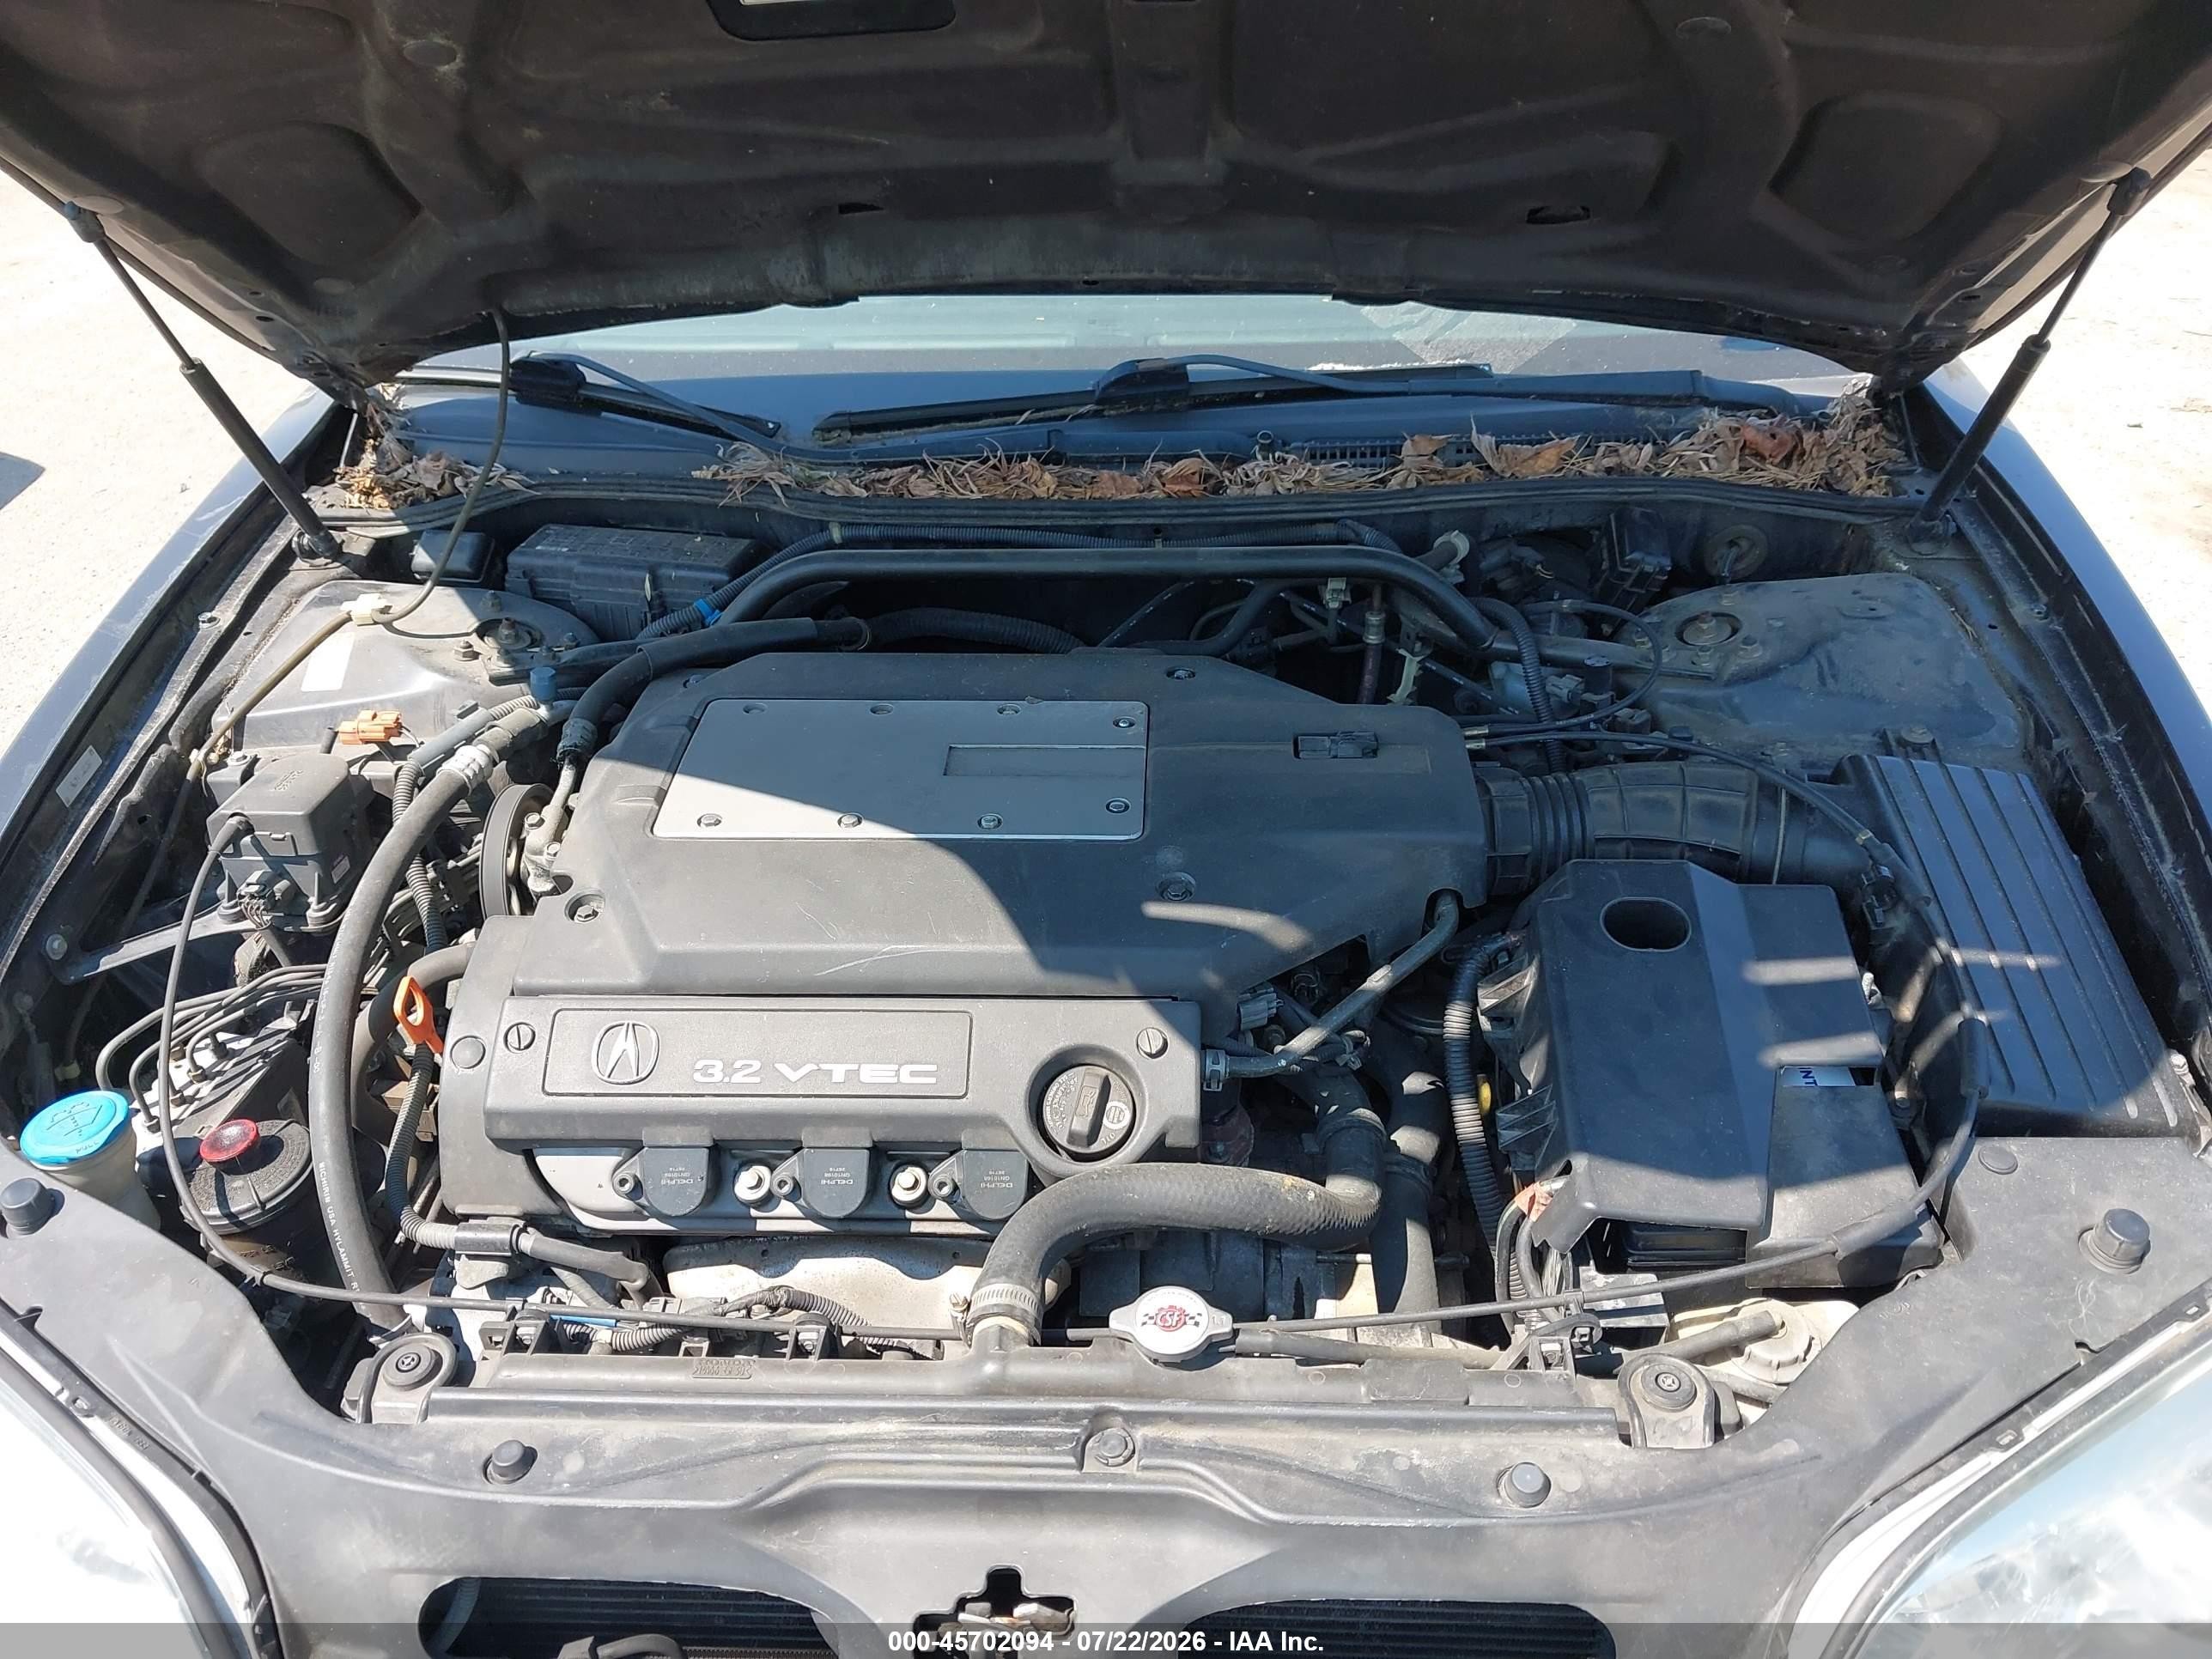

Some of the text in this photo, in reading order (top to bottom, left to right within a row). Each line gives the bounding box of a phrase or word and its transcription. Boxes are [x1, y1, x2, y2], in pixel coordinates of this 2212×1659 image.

[692, 1060, 938, 1084] 3.2 VTEC
[1101, 1132, 1116, 1145] OIL
[326, 1206, 337, 1227] USA
[332, 1229, 355, 1278] HYLAMMIT
[1158, 1310, 1182, 1328] CSF
